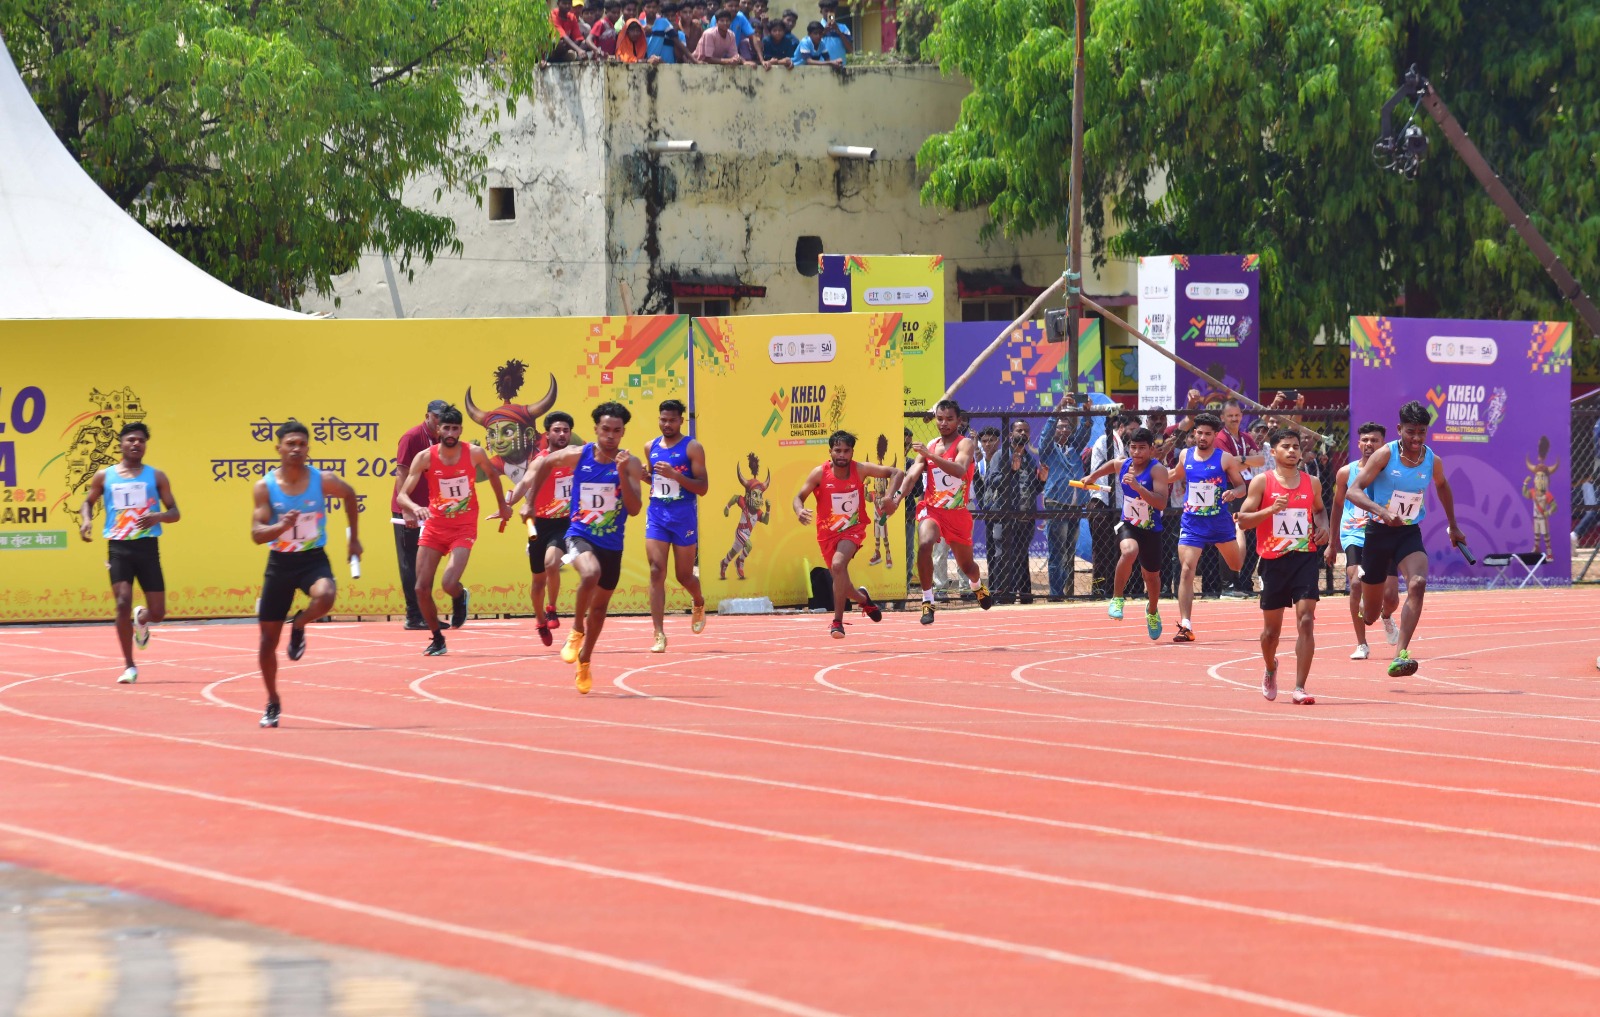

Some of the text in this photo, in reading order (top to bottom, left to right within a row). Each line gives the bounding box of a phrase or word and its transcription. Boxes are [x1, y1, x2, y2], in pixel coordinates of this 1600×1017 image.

[1207, 315, 1236, 325] KHELO
[1205, 326, 1231, 335] INDIA
[773, 343, 784, 351] FIT
[791, 385, 826, 403] KHELO
[1447, 385, 1485, 403] KHELO
[790, 405, 821, 423] INDIA
[1446, 403, 1479, 421] INDIA
[312, 417, 379, 445] इंडिया
[942, 475, 953, 487] C
[449, 485, 461, 497] H
[562, 485, 572, 497] H
[661, 484, 671, 496] D
[124, 493, 136, 507] L
[592, 494, 605, 508] D
[1195, 492, 1206, 504] N
[841, 501, 853, 513] C
[1131, 506, 1140, 518] N
[1396, 502, 1415, 517] M
[293, 525, 305, 540] L
[1277, 519, 1304, 536] AA
